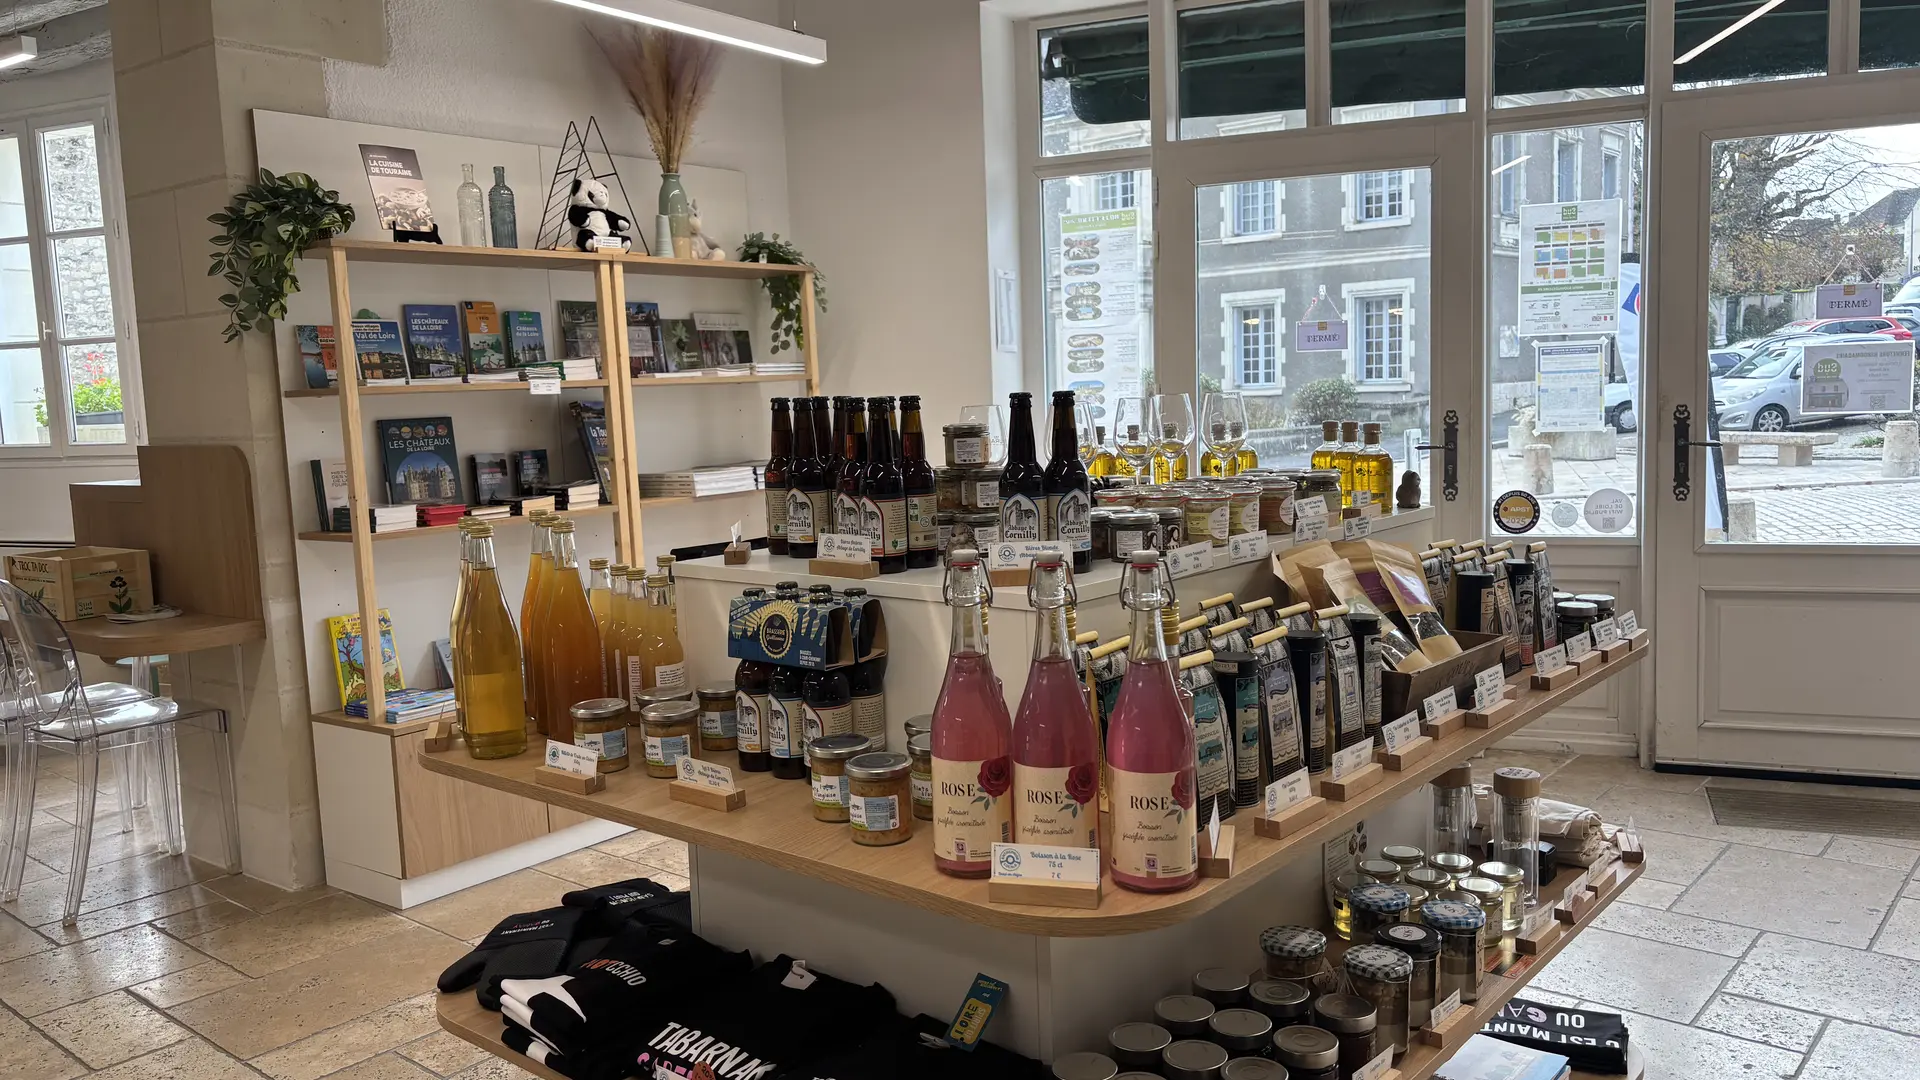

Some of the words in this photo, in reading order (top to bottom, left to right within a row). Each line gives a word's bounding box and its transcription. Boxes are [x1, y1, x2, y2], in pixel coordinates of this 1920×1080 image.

[381, 168, 412, 176] TOURAINE
[1829, 299, 1869, 309] FERMÉ
[1307, 333, 1340, 343] FERMÉ
[389, 441, 404, 449] LES
[407, 438, 451, 447] CHÂTEAUX
[1506, 517, 1526, 526] 2025
[1005, 531, 1037, 539] Cornilly
[941, 781, 976, 797] ROSE
[1027, 789, 1063, 804] ROSE
[1130, 795, 1169, 810] ROSE
[1030, 851, 1053, 860] Boisson
[1054, 852, 1059, 860] à
[1067, 853, 1081, 861] Rose
[955, 1003, 978, 1035] LOIRE
[1556, 1012, 1585, 1028] OU
